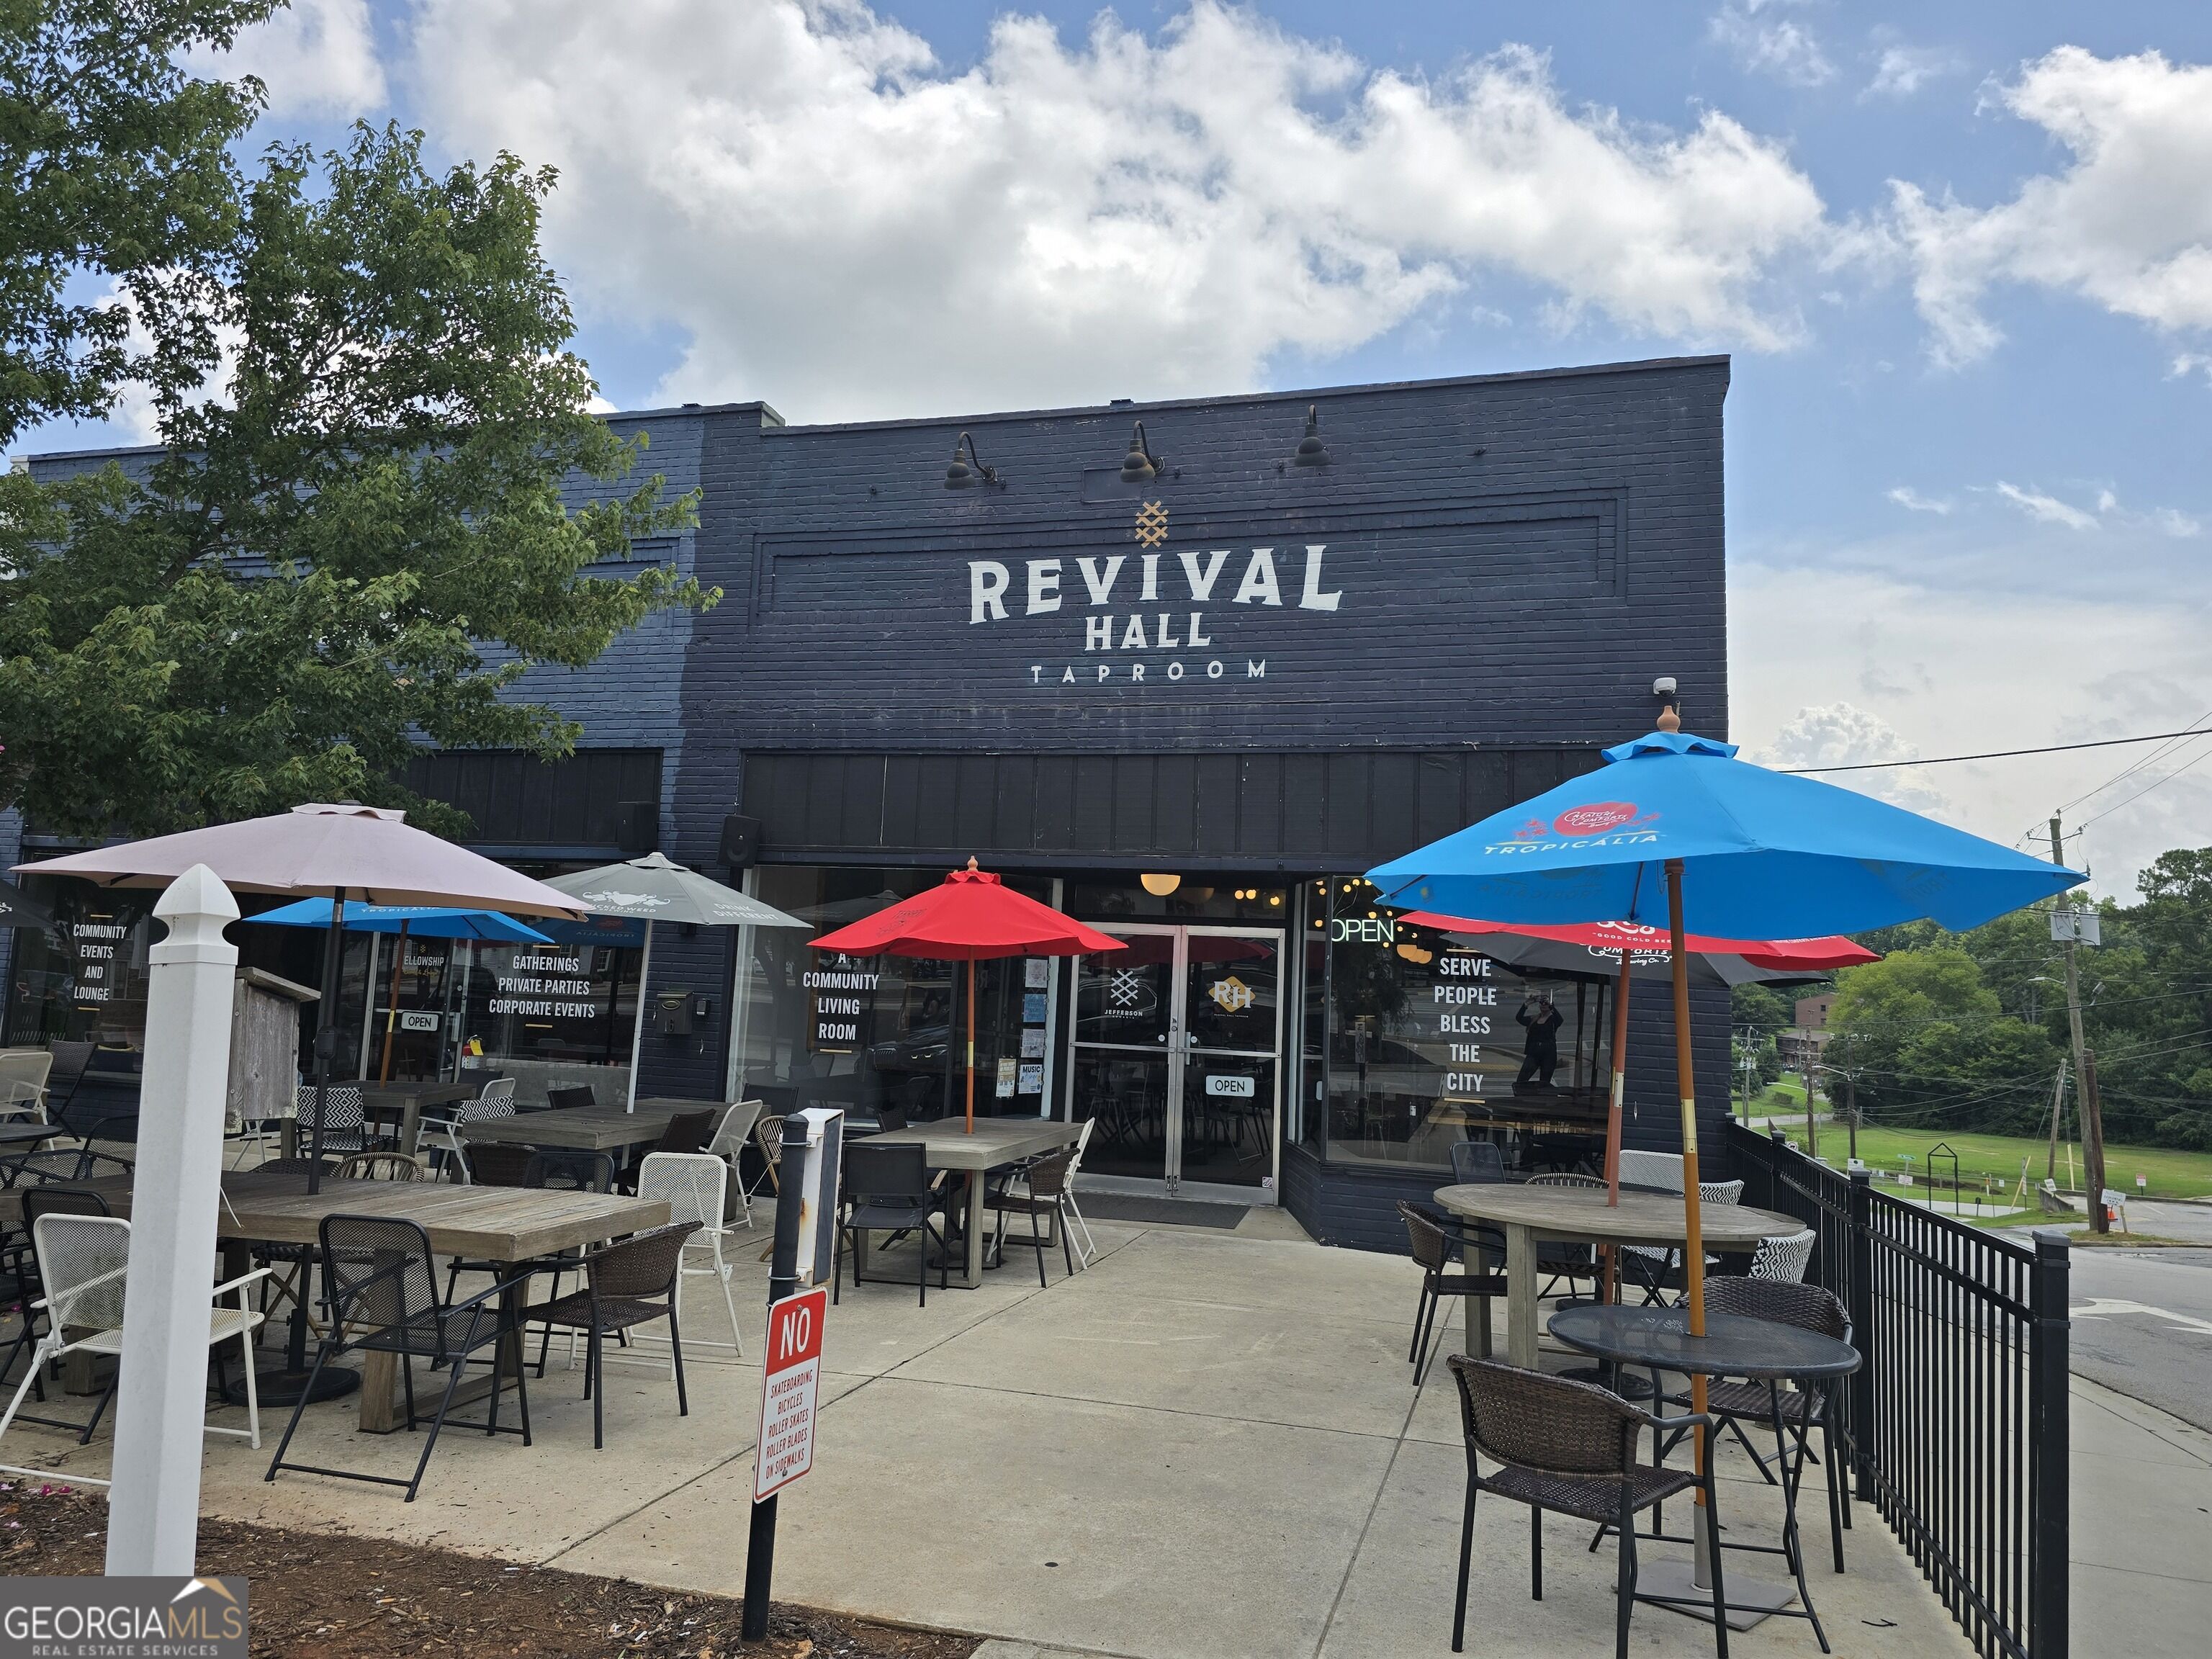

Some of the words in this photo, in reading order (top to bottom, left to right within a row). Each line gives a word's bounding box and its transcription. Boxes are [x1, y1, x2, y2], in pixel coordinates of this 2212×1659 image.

[967, 544, 1343, 625] REVIVAL
[1084, 611, 1212, 651] HALL
[1030, 658, 1267, 684] TAPROOM
[712, 910, 779, 920] DIFFERENT
[714, 903, 755, 912] DRINK
[73, 924, 127, 939] COMMUNITY
[1331, 919, 1394, 943] OPEN
[80, 945, 114, 958] EVENTS
[404, 956, 444, 966] ELLOWSHIP
[837, 953, 847, 963] A
[84, 966, 104, 979] AND
[513, 955, 579, 971] GATHERINGS
[1440, 957, 1491, 976] SERVE
[498, 977, 542, 993] PRIVATE
[544, 979, 590, 995] PARTIES
[803, 972, 879, 990] COMMUNITY
[73, 986, 109, 1001] LOUNGE
[1434, 985, 1497, 1006] PEOPLE
[489, 999, 552, 1016] CORPORATE
[554, 1002, 595, 1018] EVENTS
[817, 997, 860, 1015] LIVING
[408, 1016, 432, 1028] OPEN
[818, 1022, 857, 1040] ROOM
[1440, 1014, 1491, 1035] BLESS
[1449, 1043, 1480, 1063] THE
[1215, 1079, 1245, 1092] OPEN
[1446, 1072, 1483, 1092] CITY
[780, 1307, 811, 1360] NO
[770, 1370, 813, 1399] SKATEBOARDING
[778, 1392, 804, 1415] BICYCLES
[768, 1417, 788, 1439] ROLLER
[789, 1408, 809, 1429] SKATES
[766, 1437, 786, 1460] ROLLER
[787, 1428, 808, 1449] BLADES
[765, 1464, 774, 1479] ON
[775, 1447, 805, 1474] SIDEWALKS
